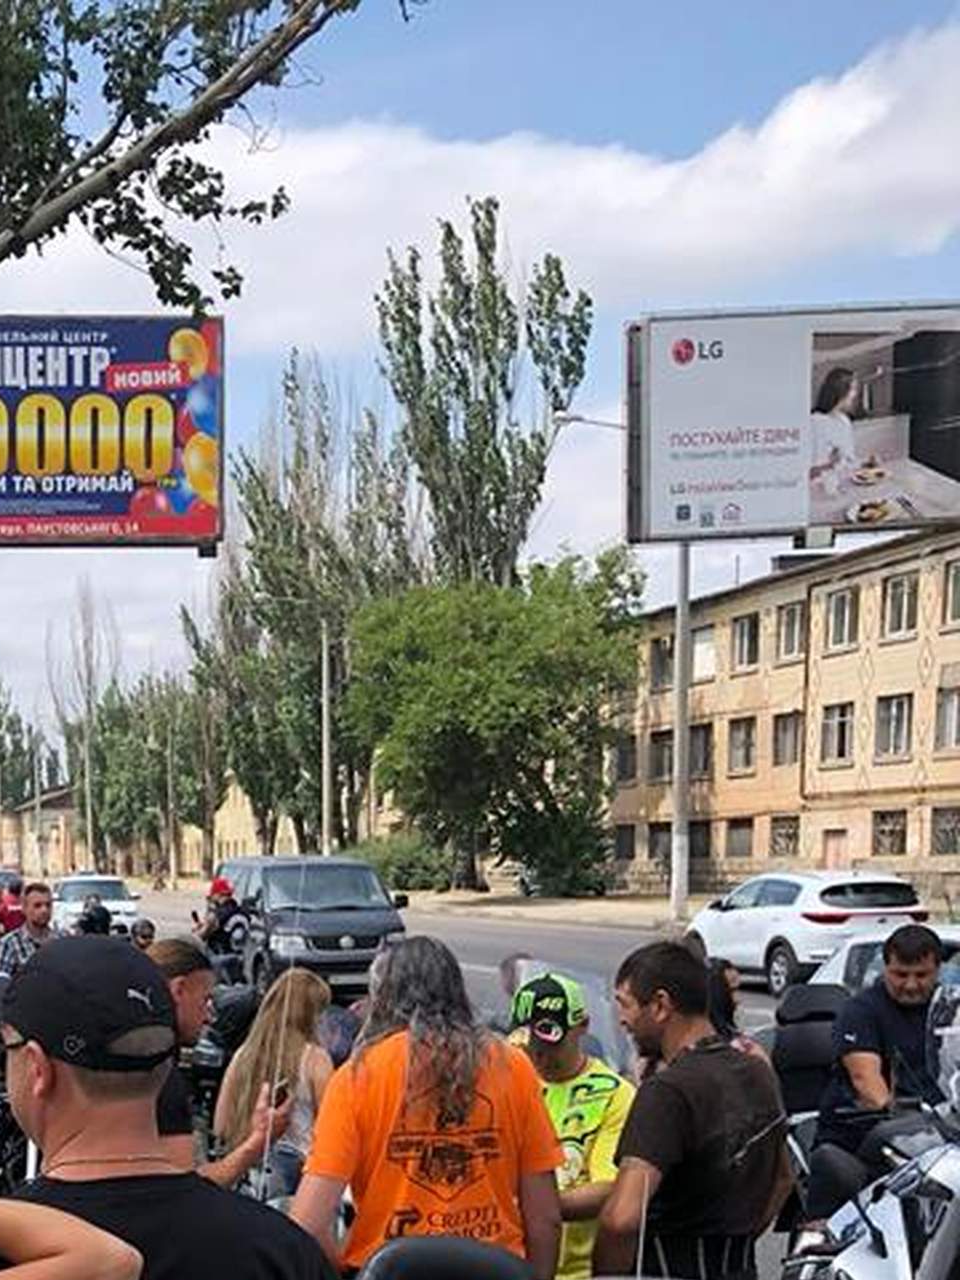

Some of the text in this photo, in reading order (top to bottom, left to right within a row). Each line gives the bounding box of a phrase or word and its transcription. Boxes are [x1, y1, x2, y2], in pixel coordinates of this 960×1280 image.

[63, 332, 109, 344] ЦЕНТР
[698, 340, 724, 359] LG
[113, 365, 182, 389] НОВИЙ
[13, 476, 36, 493] ТА
[41, 470, 134, 493] ОТРИМАЙ
